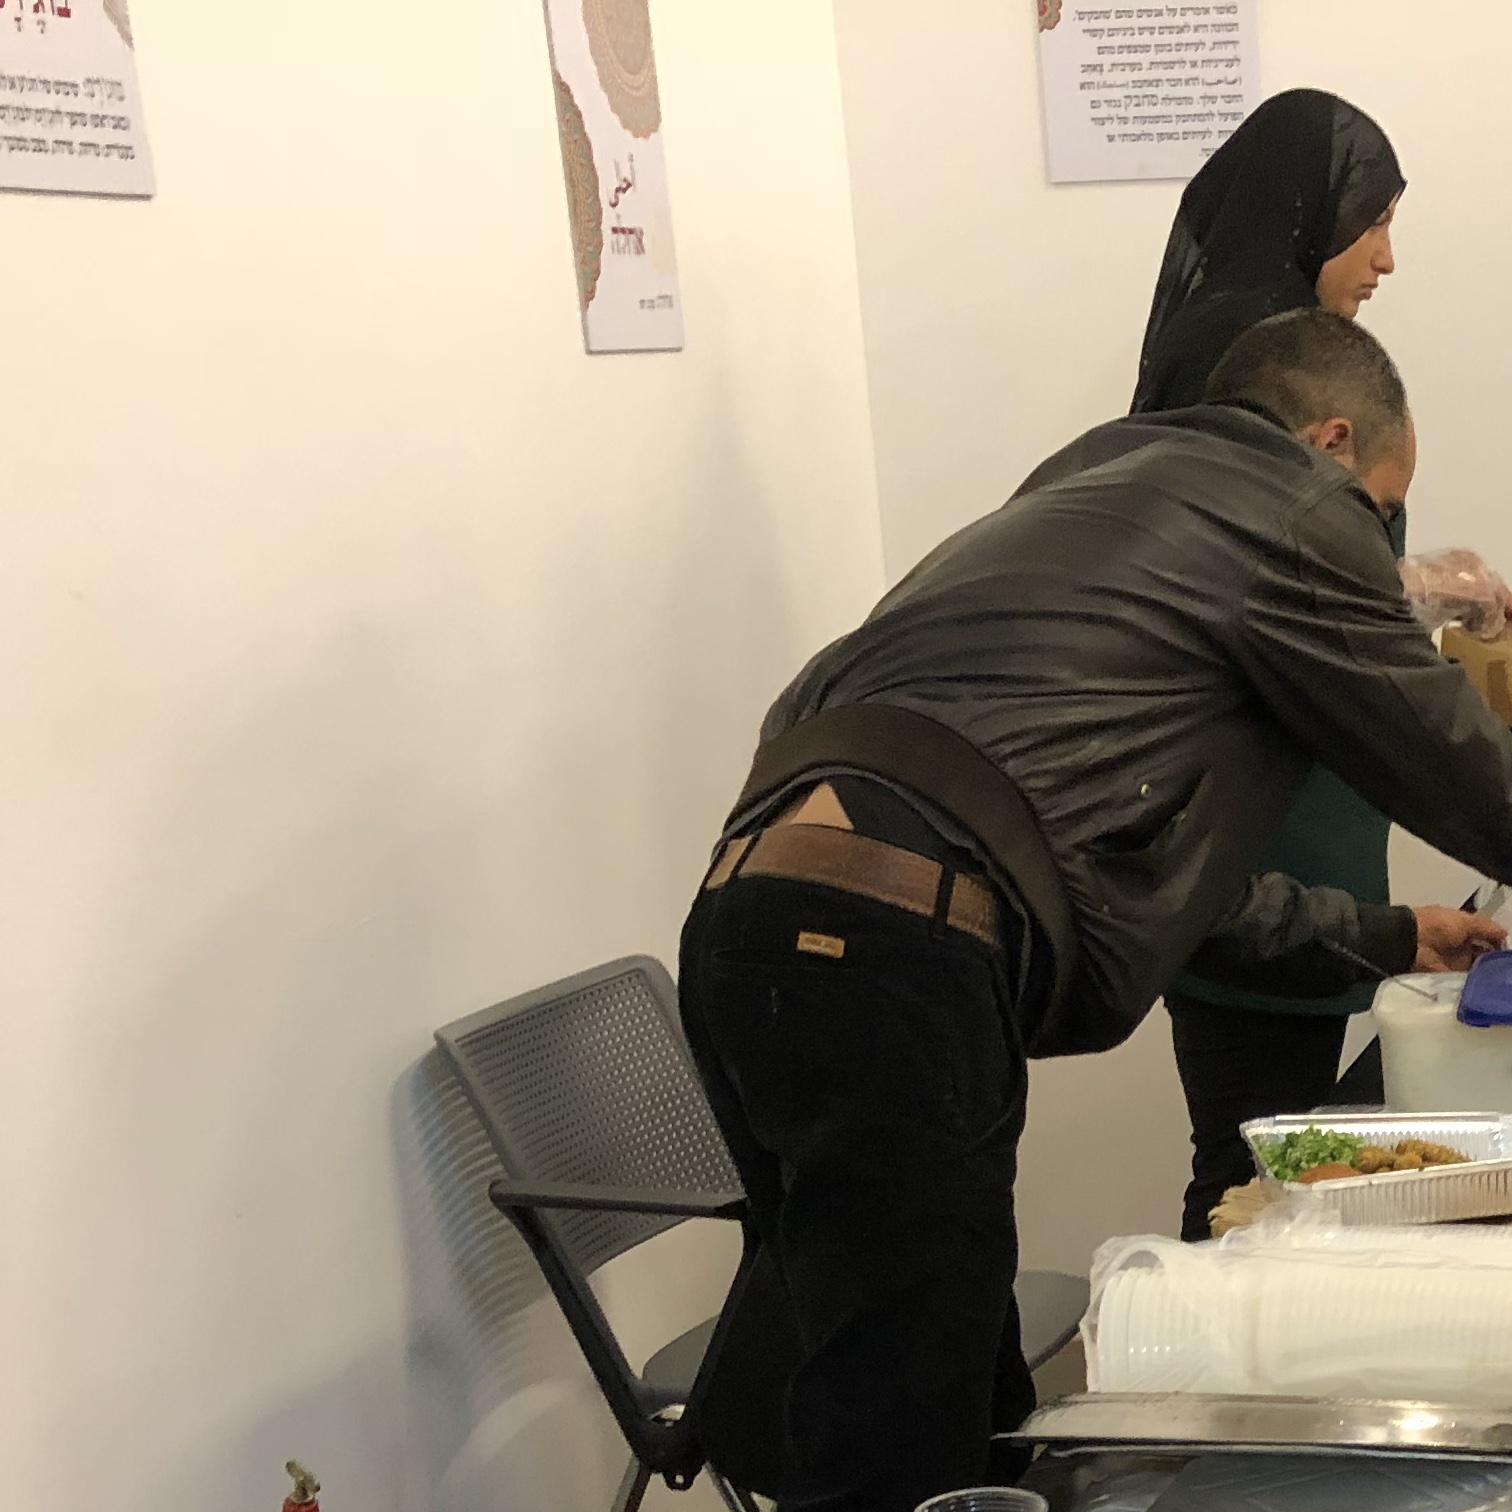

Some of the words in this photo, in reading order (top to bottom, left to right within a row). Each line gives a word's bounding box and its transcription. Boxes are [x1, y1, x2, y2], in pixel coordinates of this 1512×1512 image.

[1165, 5, 1178, 18] על
[1138, 26, 1156, 36] שיש
[1158, 22, 1190, 35] לאנשים
[1193, 24, 1208, 34] היא
[1188, 60, 1198, 68] או
[1124, 94, 1158, 112] סחבק
[1116, 114, 1130, 125] של
